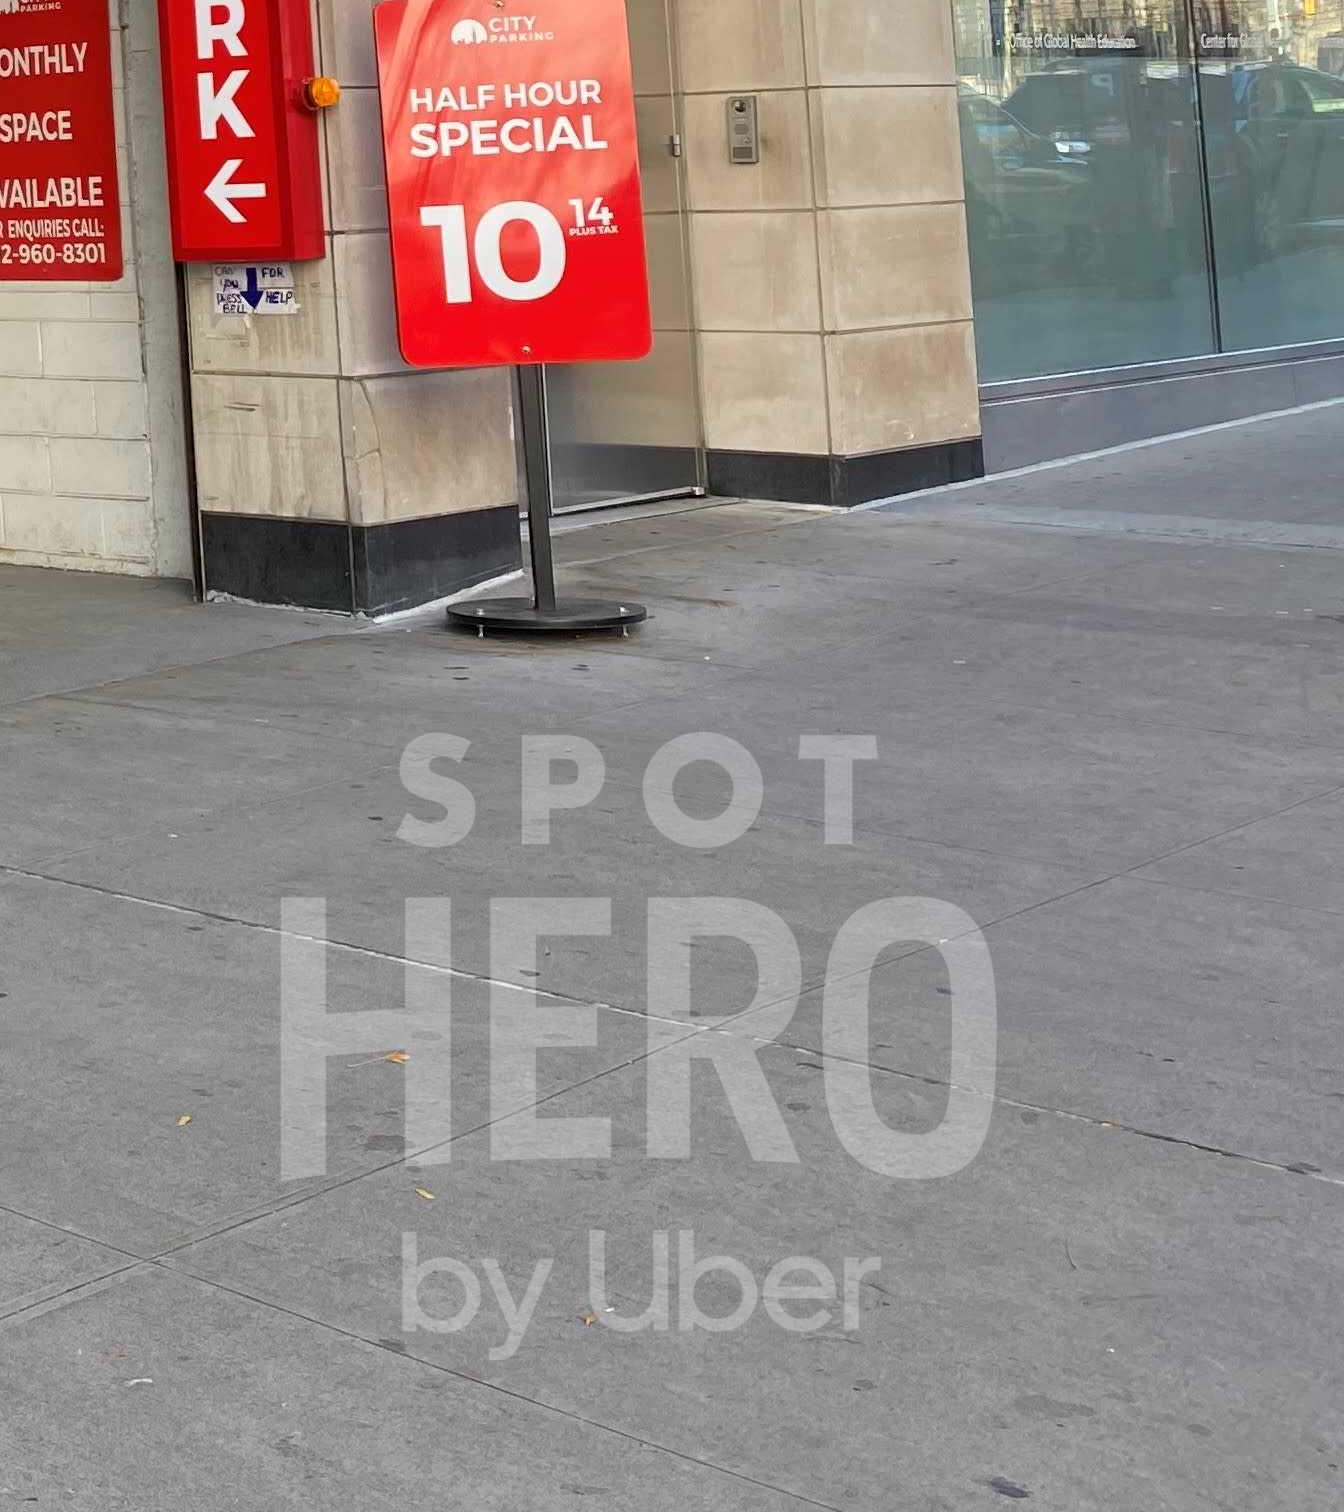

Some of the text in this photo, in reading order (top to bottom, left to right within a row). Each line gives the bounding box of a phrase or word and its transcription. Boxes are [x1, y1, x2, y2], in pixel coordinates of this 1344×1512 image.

[20, 2, 61, 12] PARKING
[488, 16, 536, 33] CITY
[489, 31, 554, 44] PARKING
[409, 79, 602, 113] HALF HOUR
[0, 110, 73, 142] SPACE
[410, 114, 608, 158] SPECIAL
[8, 219, 70, 241] ENQUIRIES
[569, 225, 619, 237] PLUS TAX
[420, 197, 614, 304] 10 14
[261, 267, 285, 278] FOR
[265, 291, 293, 304] HELP
